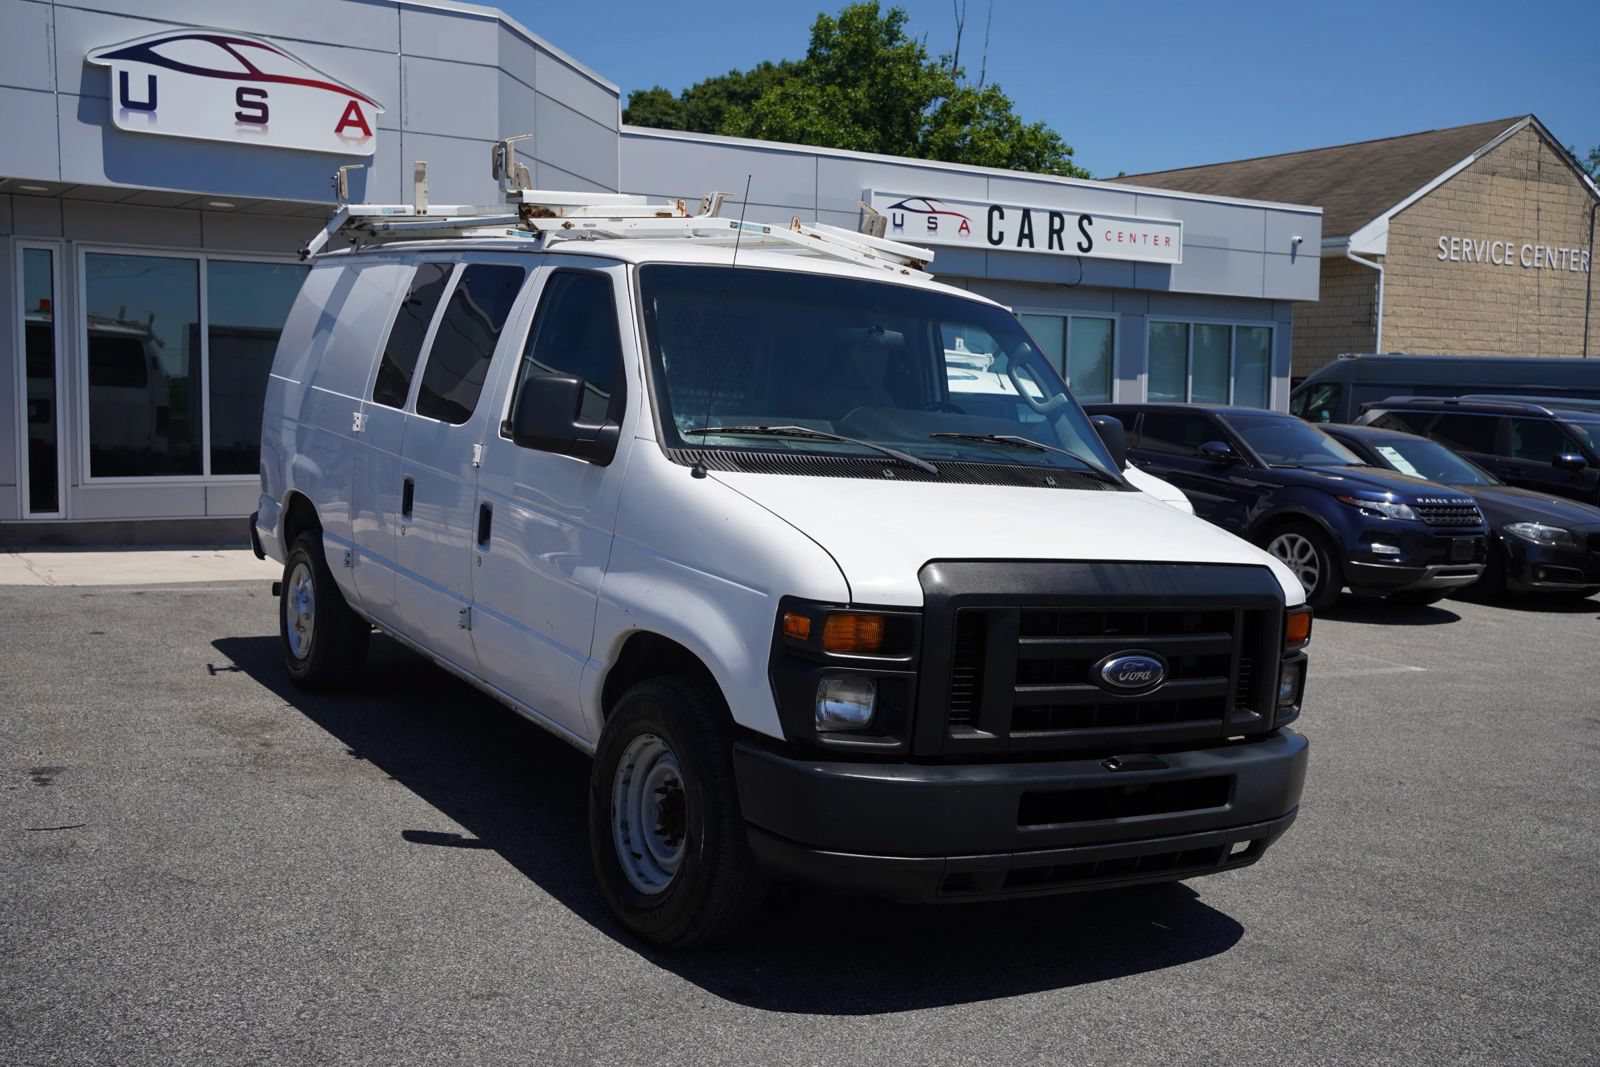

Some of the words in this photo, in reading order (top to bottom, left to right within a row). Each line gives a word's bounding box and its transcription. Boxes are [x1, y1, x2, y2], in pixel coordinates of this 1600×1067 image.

[119, 70, 373, 137] USA
[986, 204, 1094, 253] CARS
[1105, 230, 1171, 247] CENTER
[1437, 235, 1514, 266] SERVICE
[1520, 244, 1590, 273] CENTER
[1118, 661, 1152, 681] Ford
